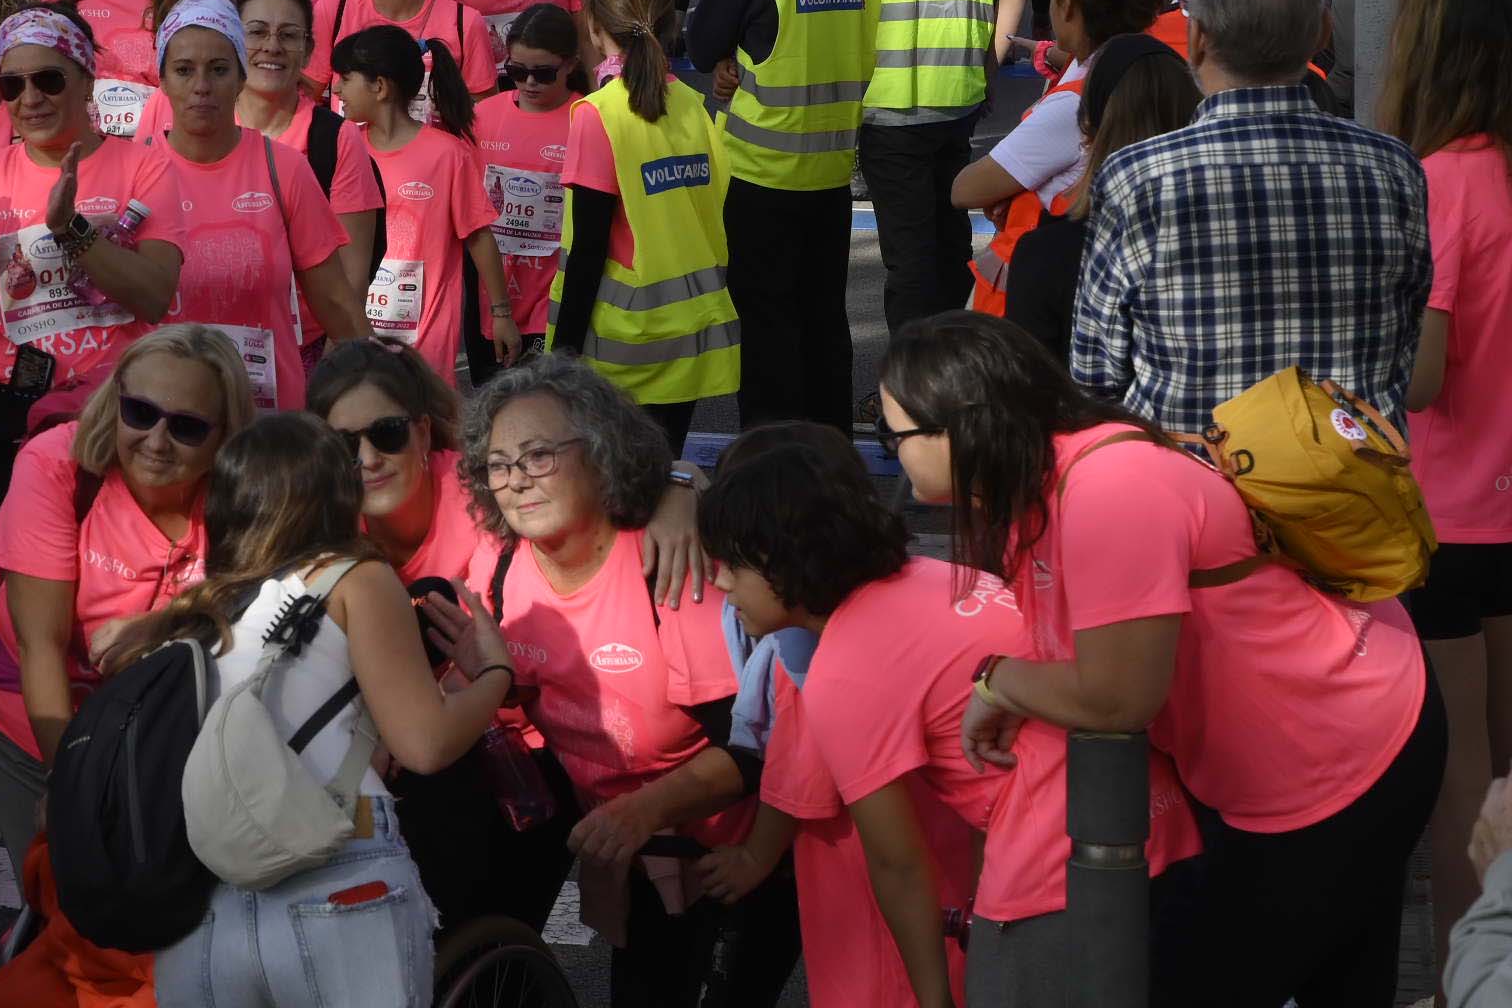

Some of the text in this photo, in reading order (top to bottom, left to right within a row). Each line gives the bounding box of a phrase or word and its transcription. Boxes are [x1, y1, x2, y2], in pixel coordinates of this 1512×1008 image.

[103, 112, 134, 124] 016
[505, 202, 535, 217] 016
[39, 266, 65, 284] 01
[48, 286, 73, 299] 893
[367, 293, 388, 306] 16
[17, 318, 56, 336] OYSHO
[84, 548, 137, 580] OYSHO
[595, 655, 640, 666] ASTURIANA
